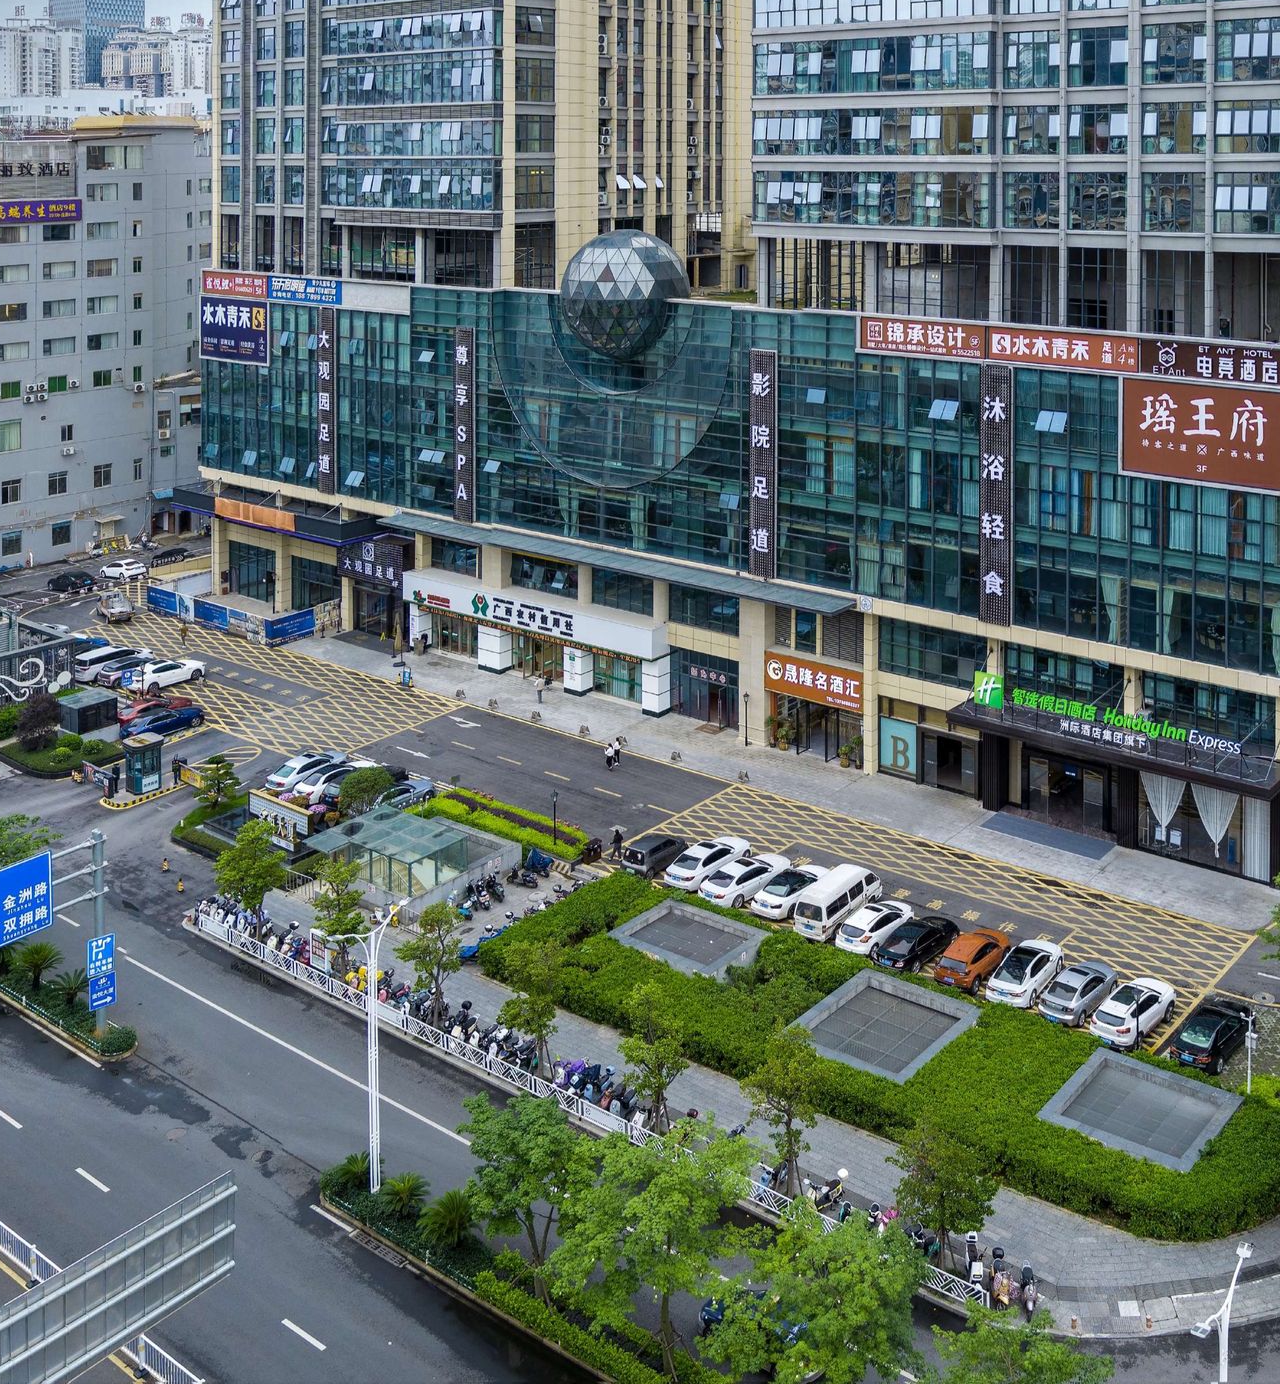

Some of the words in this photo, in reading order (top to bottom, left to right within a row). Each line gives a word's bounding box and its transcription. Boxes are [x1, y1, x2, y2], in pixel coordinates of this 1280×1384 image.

[203, 302, 251, 329] 水木青禾
[887, 321, 966, 347] 锦承设计
[1013, 335, 1089, 360] 水木青禾
[1198, 345, 1210, 353] ET
[1216, 347, 1235, 355] ANT
[1243, 349, 1273, 358] HOTEL
[1196, 356, 1277, 384] 电竞酒店
[318, 330, 330, 474] 大观园足道
[1139, 393, 1268, 446] 瑶王府
[751, 373, 770, 553] 影院足道
[1196, 464, 1207, 473] 3F
[1217, 447, 1265, 462] 广西味道
[982, 396, 1006, 597] 沐浴轻食
[344, 557, 394, 580] 大观园足道
[493, 603, 573, 632] 广西农村信用社
[784, 664, 860, 697] 晟隆名酒汇
[1012, 688, 1097, 721] 智选假日酒店
[1103, 707, 1161, 738] Holiday
[1162, 720, 1186, 741] Inn
[1189, 729, 1241, 754] Express
[1059, 719, 1146, 748] 洲际酒店集团旗下
[891, 735, 910, 770] B
[2, 881, 48, 911] 金洲路
[3, 907, 48, 933] 双拥路
